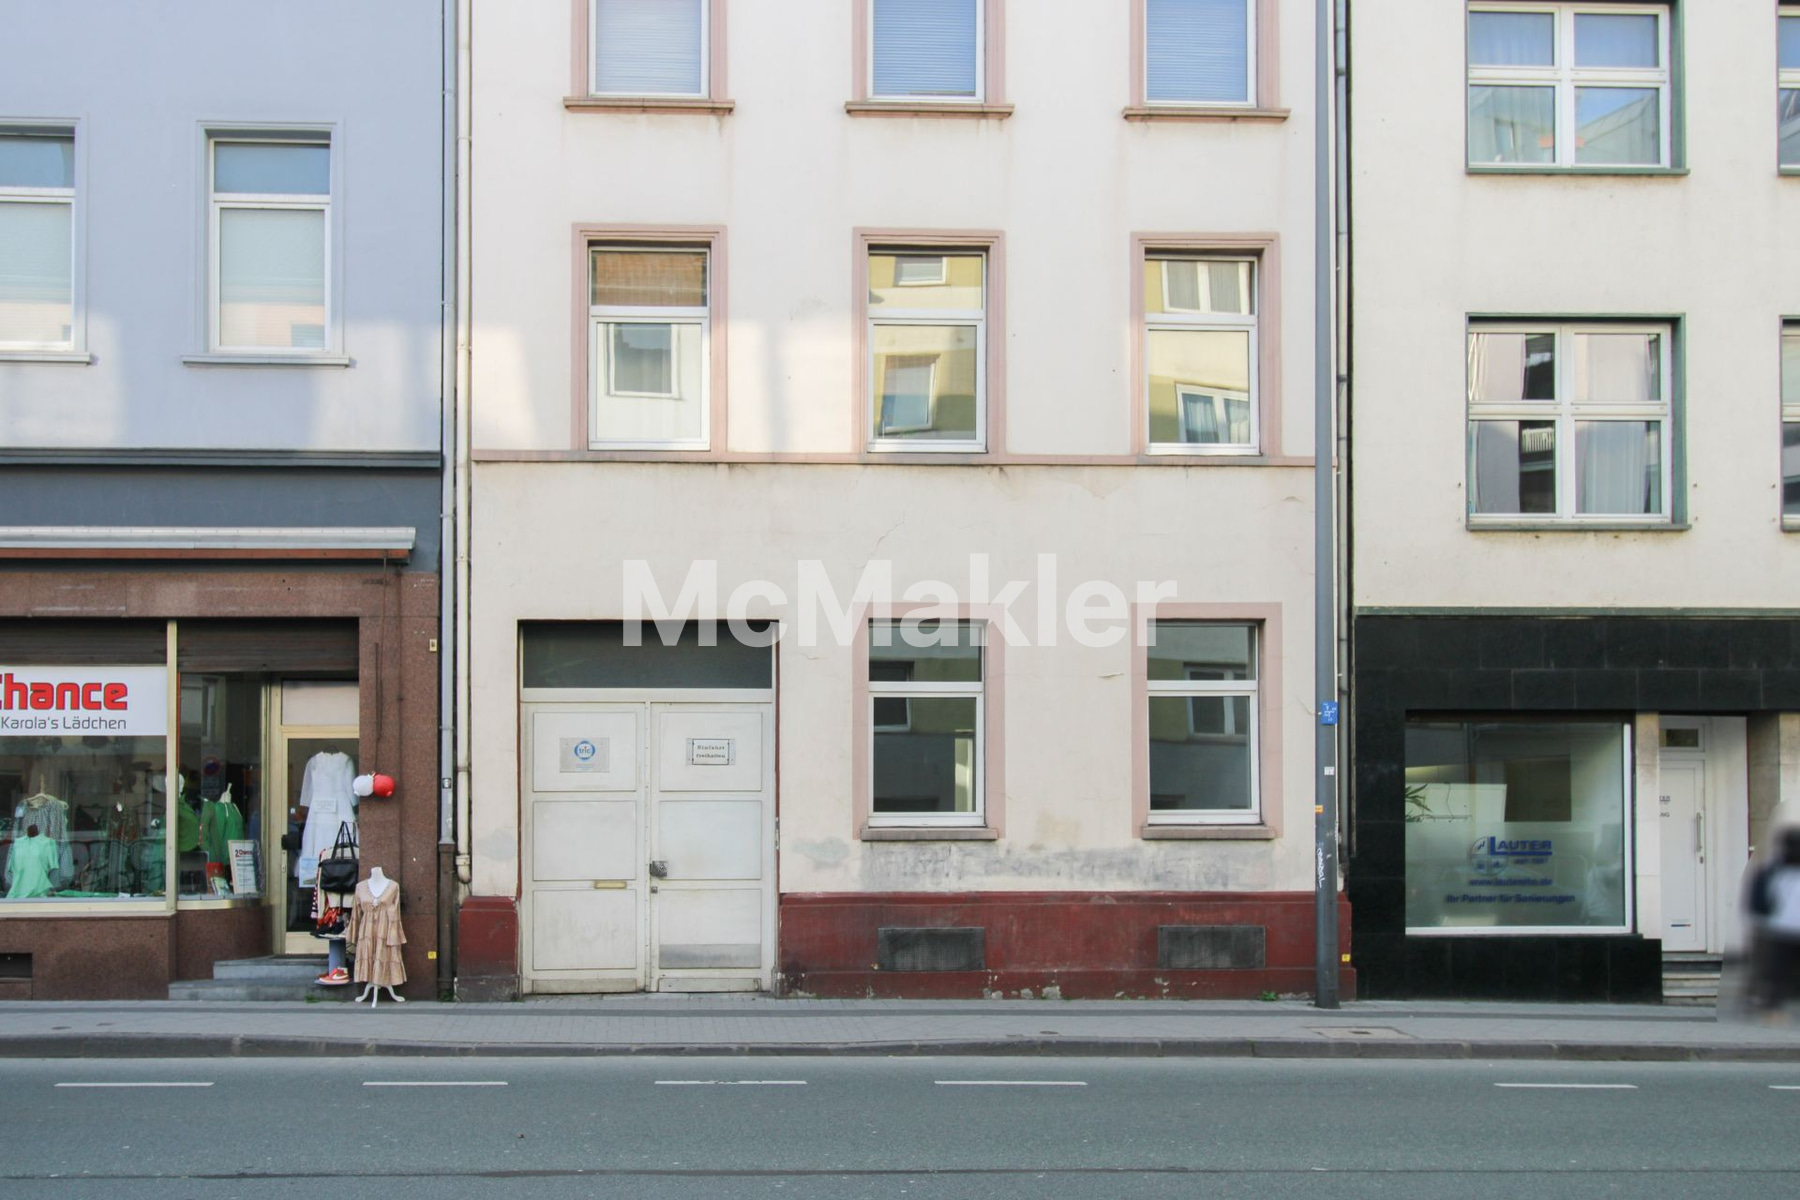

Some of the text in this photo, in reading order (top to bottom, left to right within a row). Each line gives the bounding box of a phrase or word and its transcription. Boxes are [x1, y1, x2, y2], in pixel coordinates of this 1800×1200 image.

[0, 673, 128, 710] hance
[63, 716, 127, 730] Lädchen
[1489, 836, 1552, 855] LAUTER
[1462, 894, 1497, 903] Partner
[1515, 894, 1576, 905] Sanierungen
